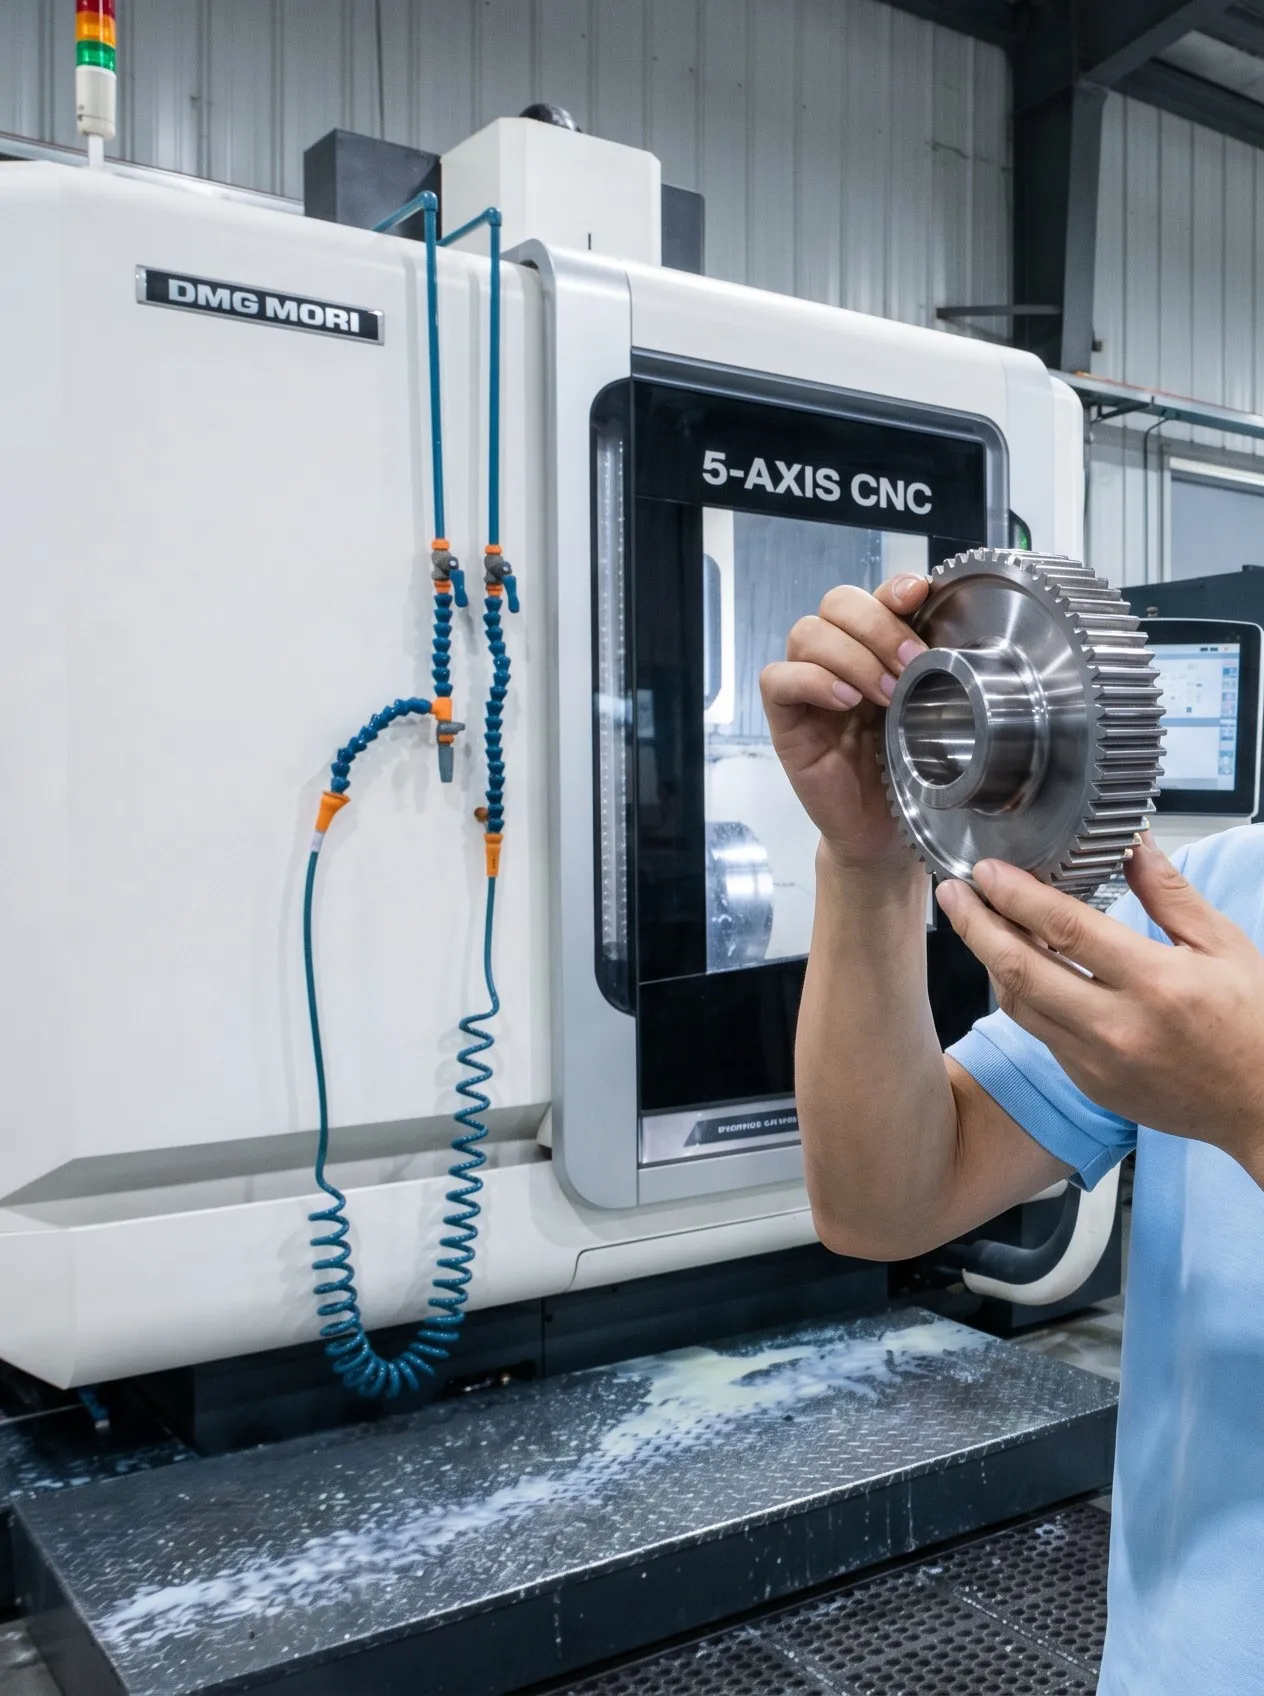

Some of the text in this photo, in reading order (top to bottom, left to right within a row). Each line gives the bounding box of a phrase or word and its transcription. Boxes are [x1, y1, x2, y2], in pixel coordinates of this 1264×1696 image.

[168, 278, 361, 333] DMG MORI
[702, 450, 933, 515] 5-AXIS CNC
